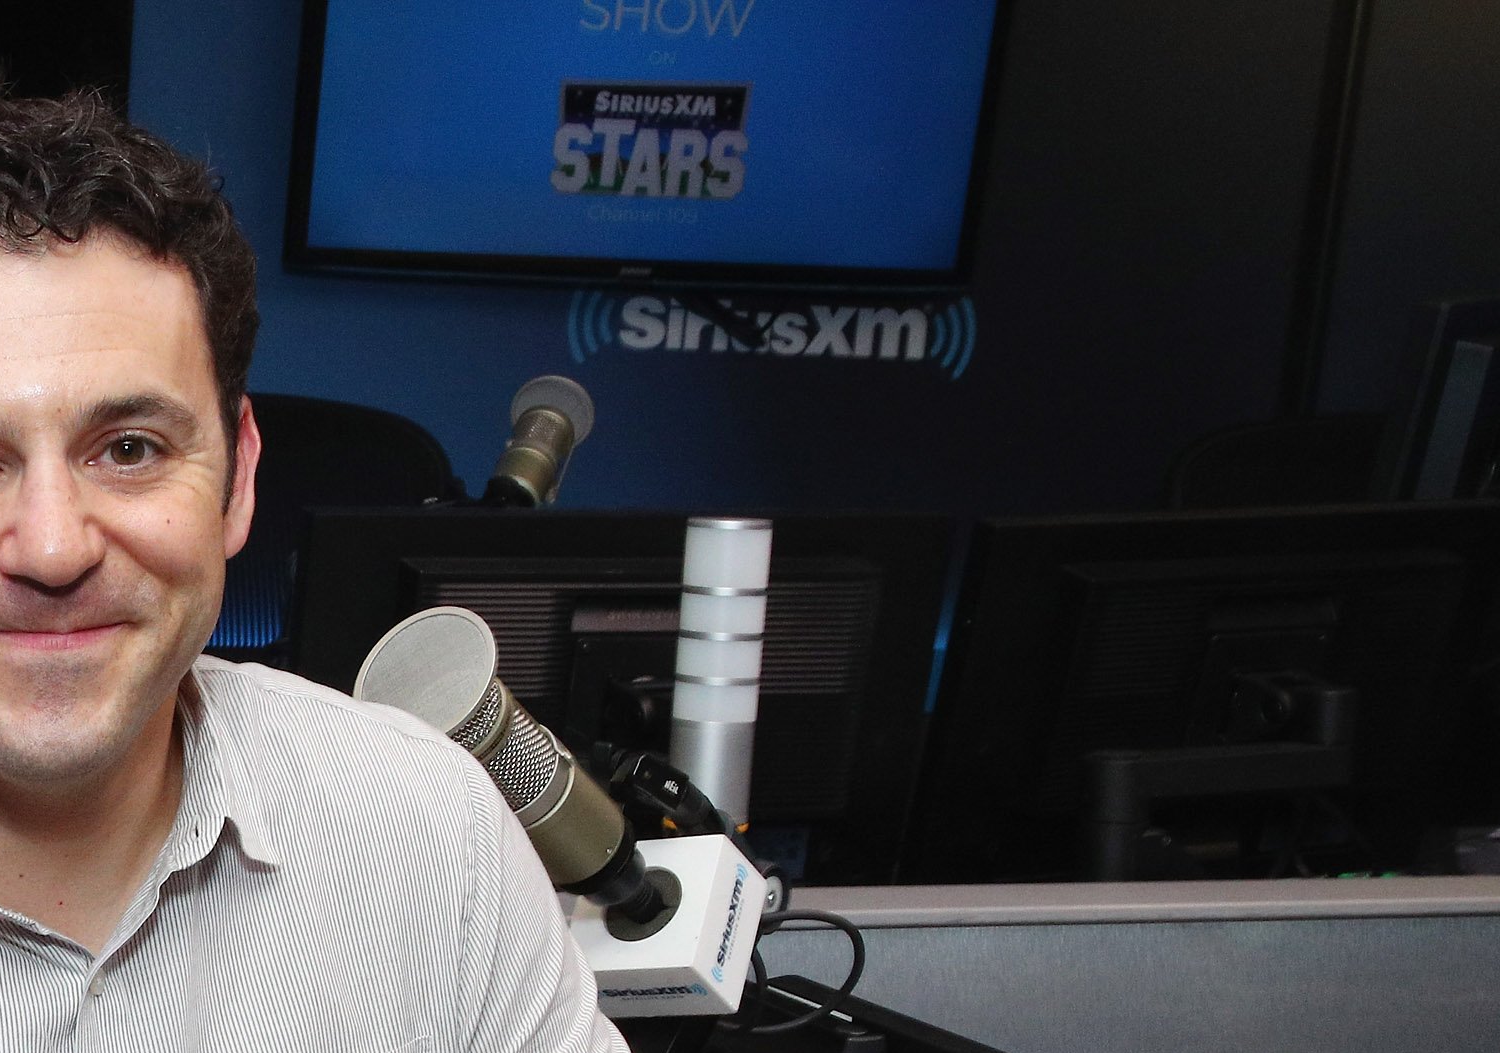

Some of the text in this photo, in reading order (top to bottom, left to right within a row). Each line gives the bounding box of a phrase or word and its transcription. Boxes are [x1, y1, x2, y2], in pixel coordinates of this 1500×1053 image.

[579, 0, 755, 38] SHOW
[550, 118, 749, 200] STARS
[587, 203, 664, 224] Channel
